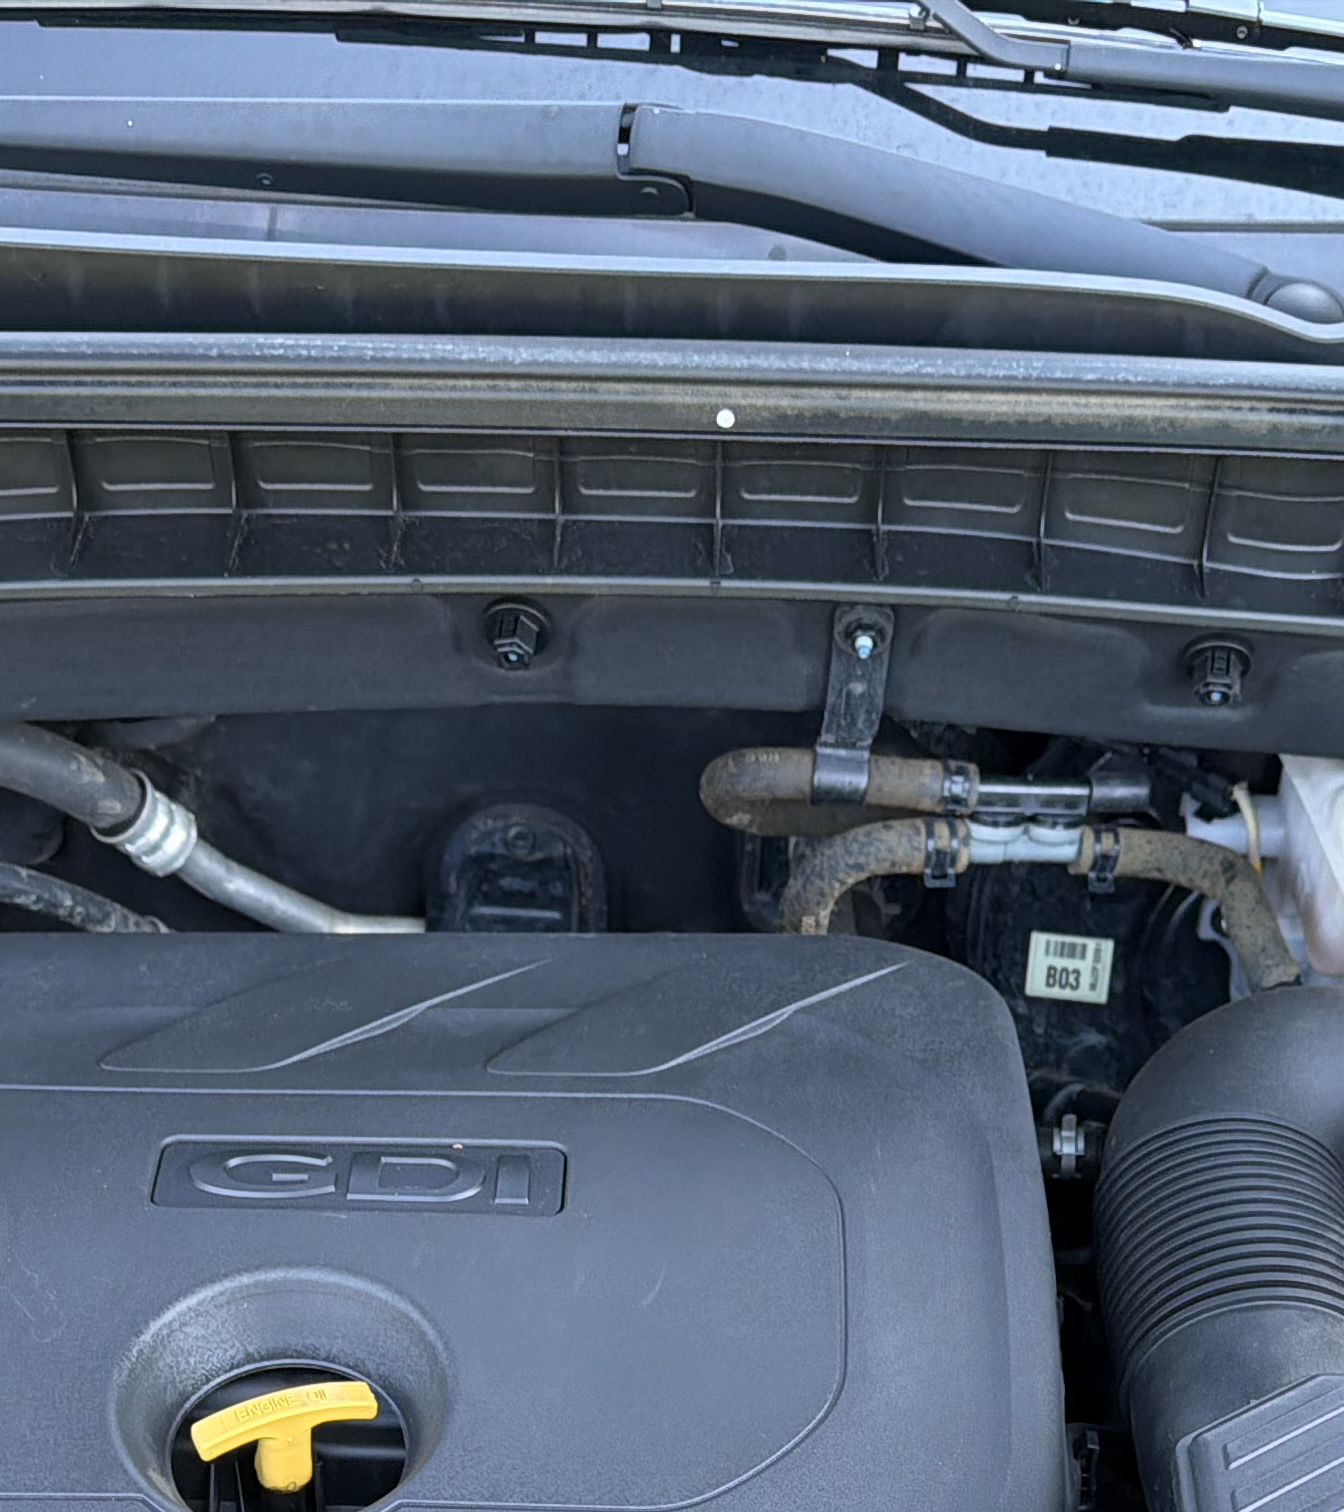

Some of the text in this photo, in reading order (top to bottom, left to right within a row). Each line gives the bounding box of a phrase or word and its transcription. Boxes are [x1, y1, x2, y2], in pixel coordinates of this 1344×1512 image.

[1045, 965, 1081, 992] B03
[190, 1149, 531, 1205] GDI
[234, 1387, 337, 1423] ENGINE OIL
